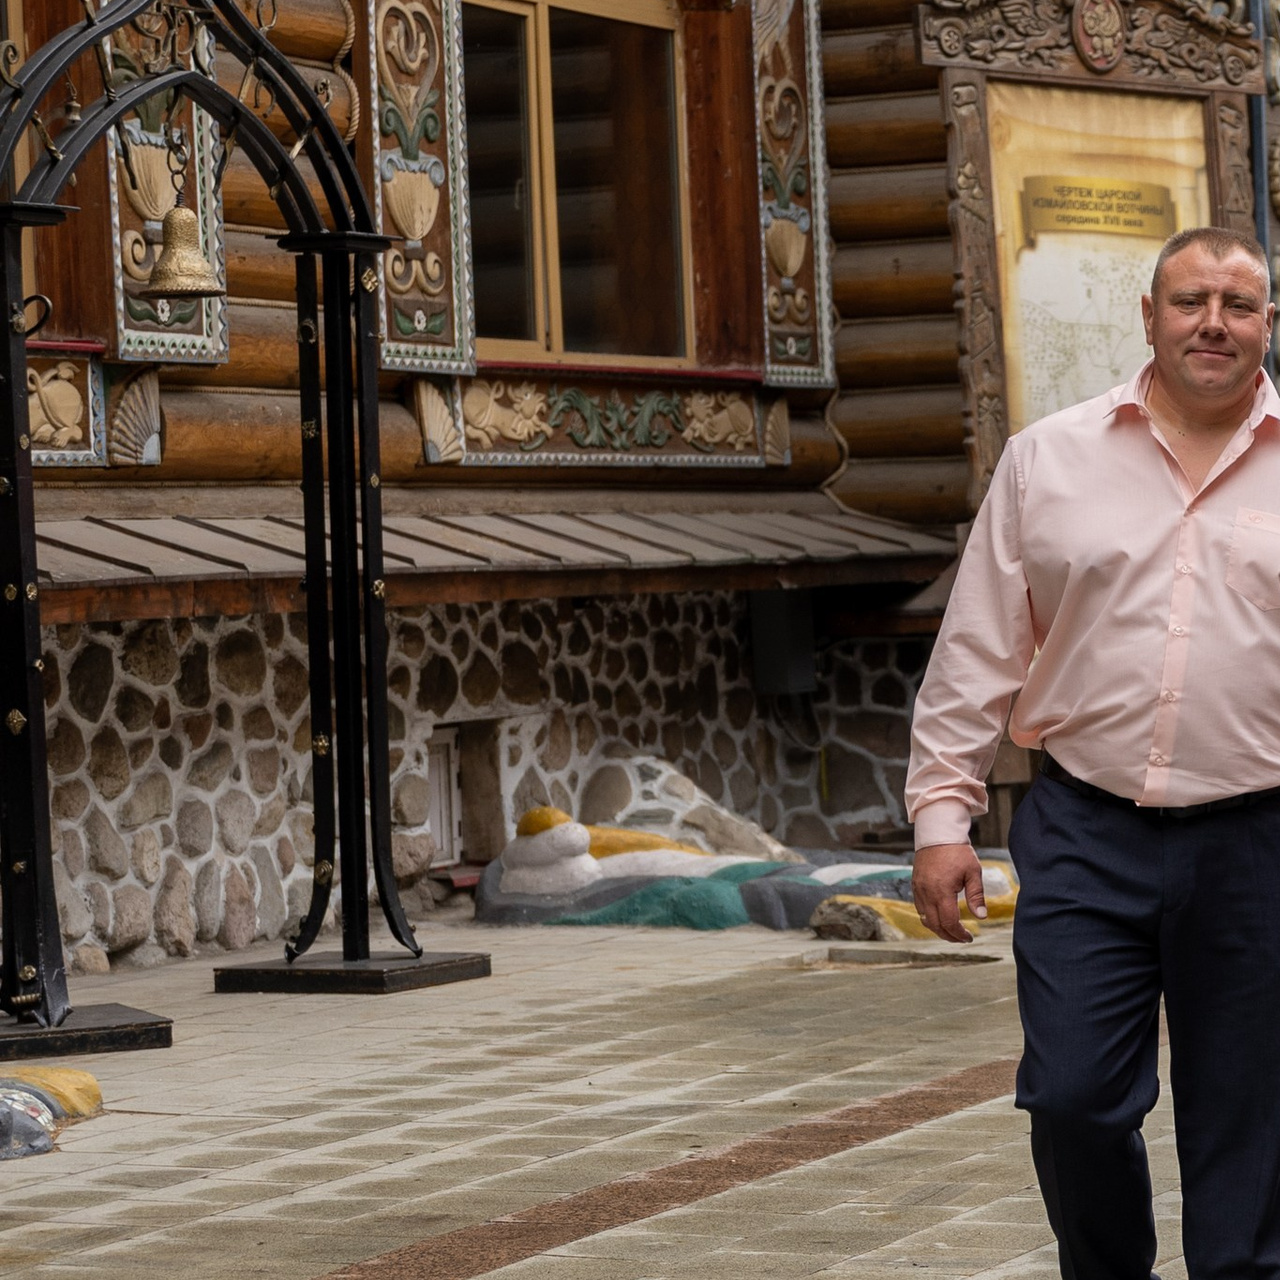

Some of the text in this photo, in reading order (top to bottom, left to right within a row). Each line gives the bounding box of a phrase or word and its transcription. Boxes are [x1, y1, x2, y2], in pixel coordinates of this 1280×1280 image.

[1054, 185, 1142, 200] ЧЕРТЕЖ ЦАРСКОЙ
[1116, 202, 1164, 215] ВОТЧИНЫ
[1055, 214, 1100, 225] середина
[1123, 219, 1144, 227] века
